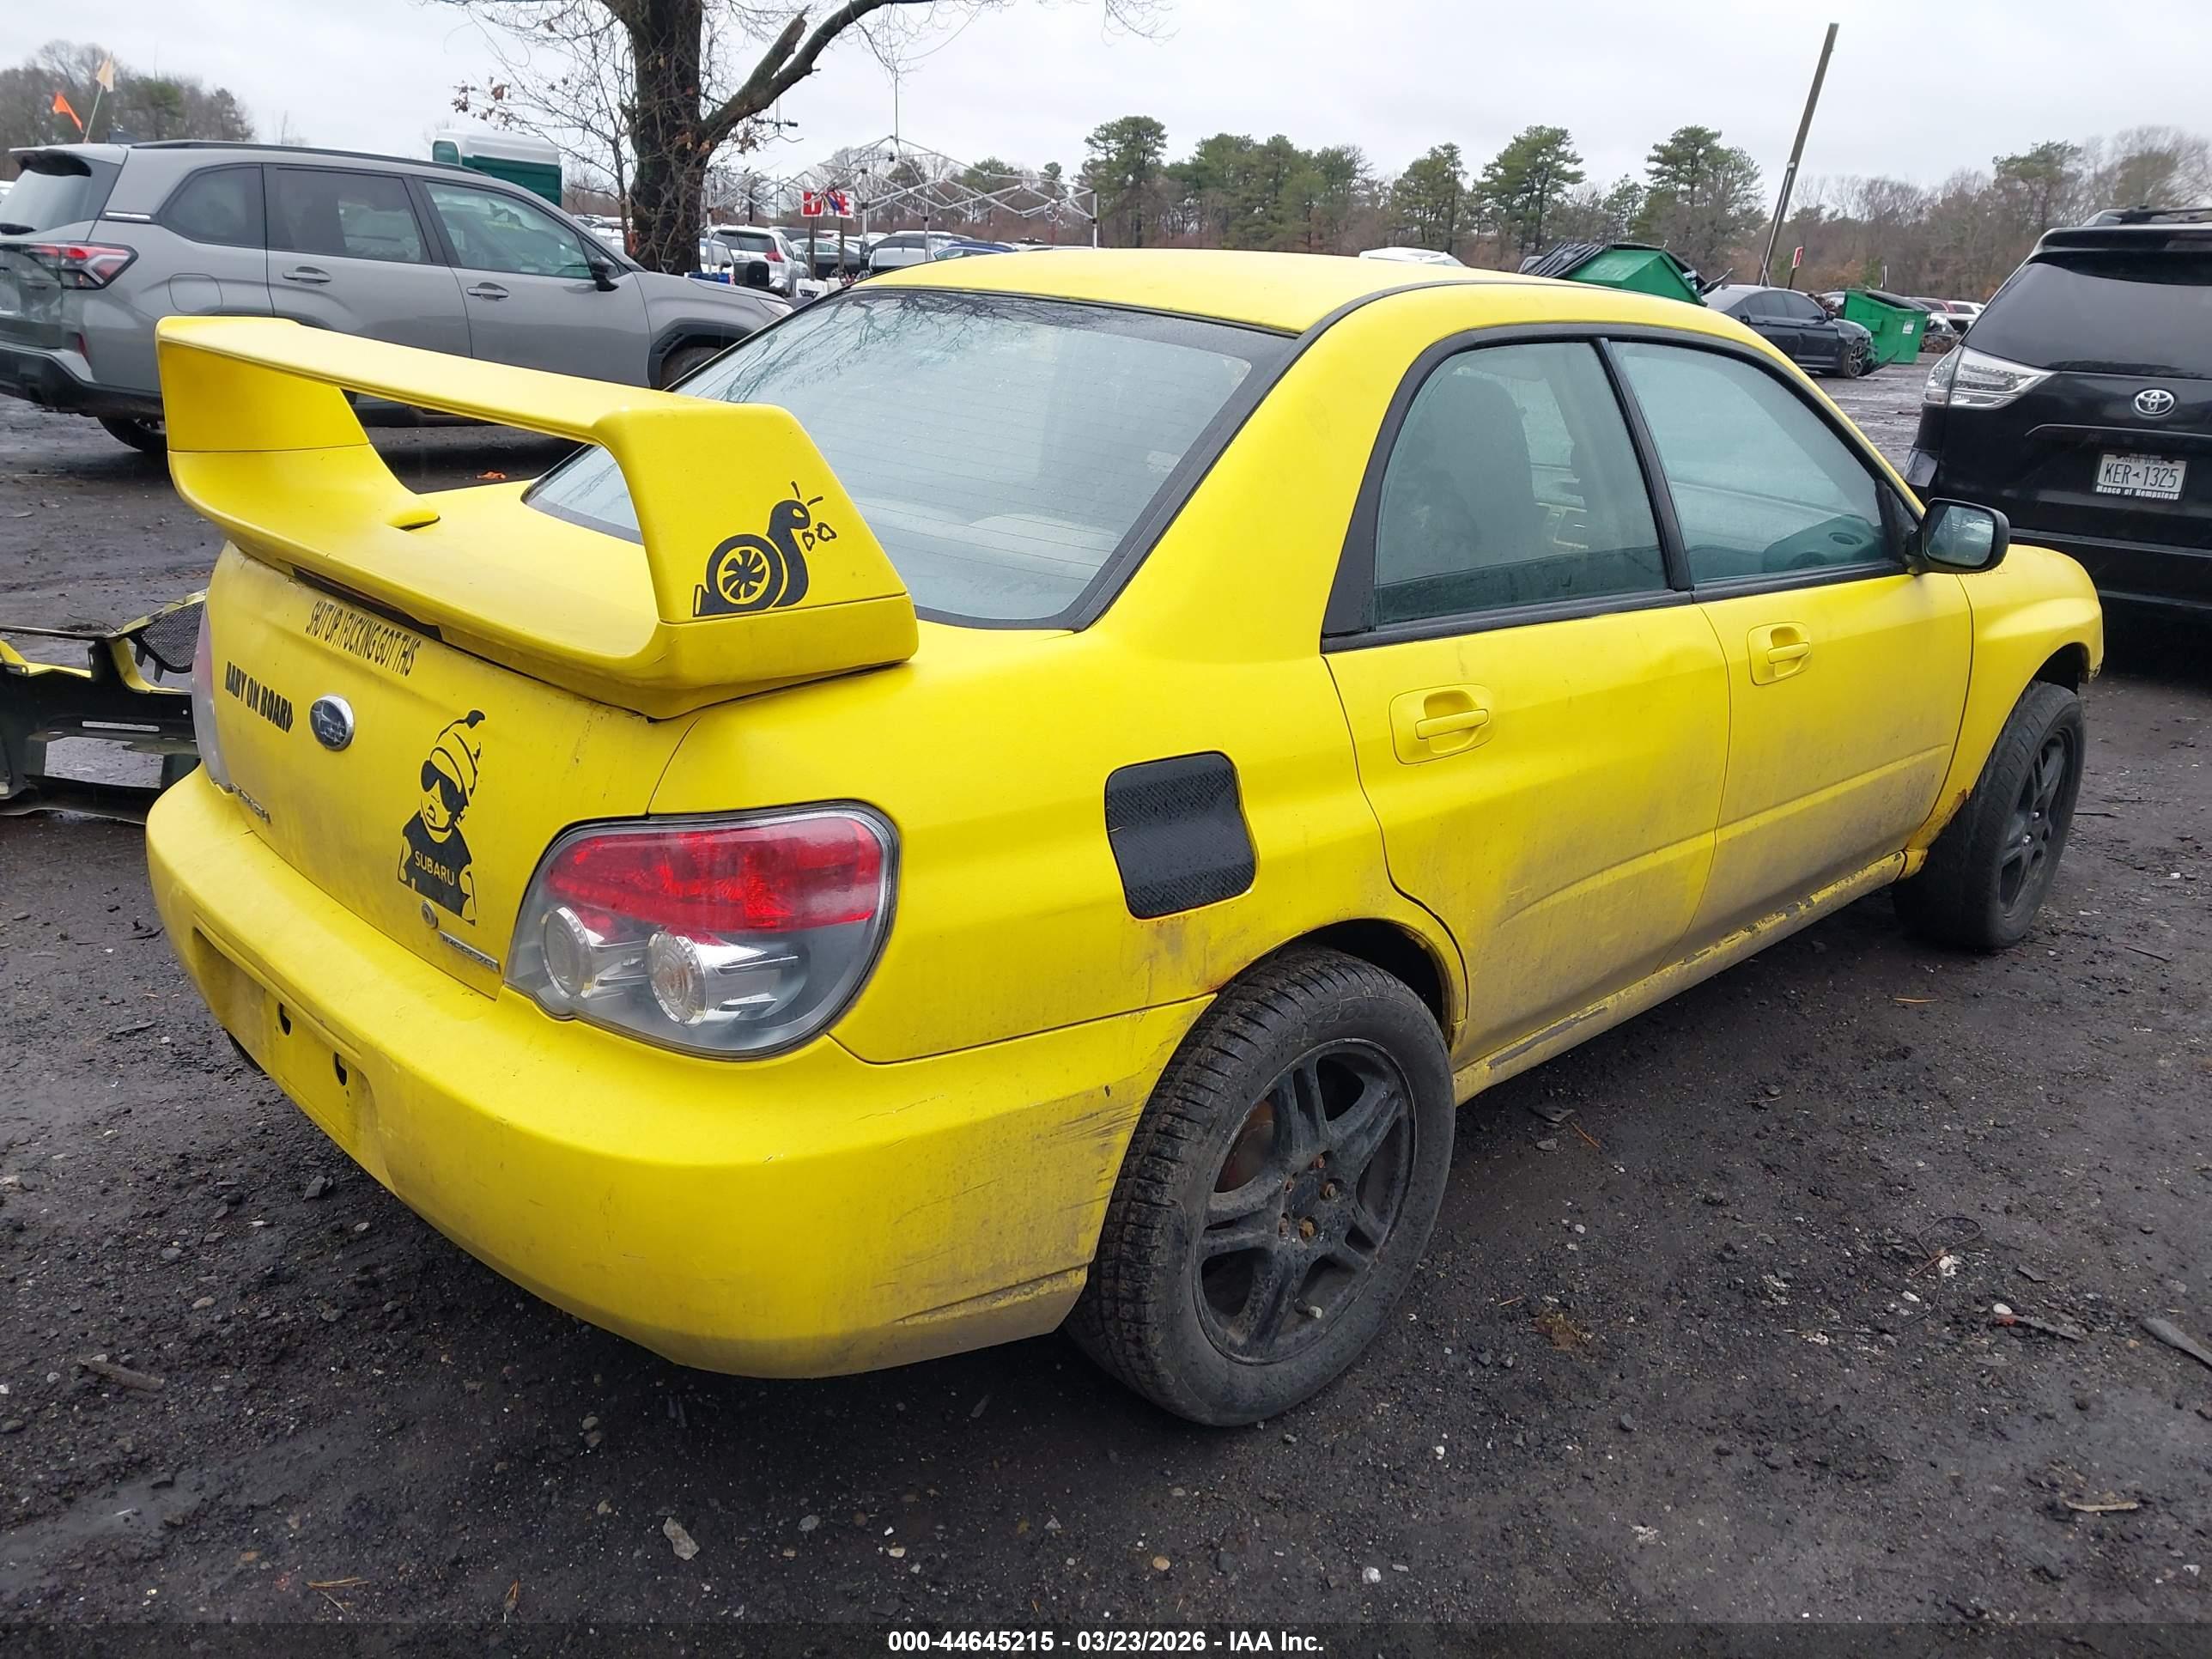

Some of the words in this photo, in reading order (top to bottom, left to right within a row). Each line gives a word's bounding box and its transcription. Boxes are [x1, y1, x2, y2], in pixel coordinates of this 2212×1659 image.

[2104, 463, 2132, 485] KER
[2143, 466, 2179, 488] 1325
[2136, 489, 2179, 500] Hempstead
[306, 599, 335, 640] SHUT
[340, 613, 381, 660] FUCKING
[375, 627, 402, 668] GOT
[392, 634, 421, 677] THIS
[225, 660, 247, 702] BABY
[246, 677, 261, 713] ON
[260, 685, 294, 733] BOARD
[415, 851, 453, 886] SUBARU
